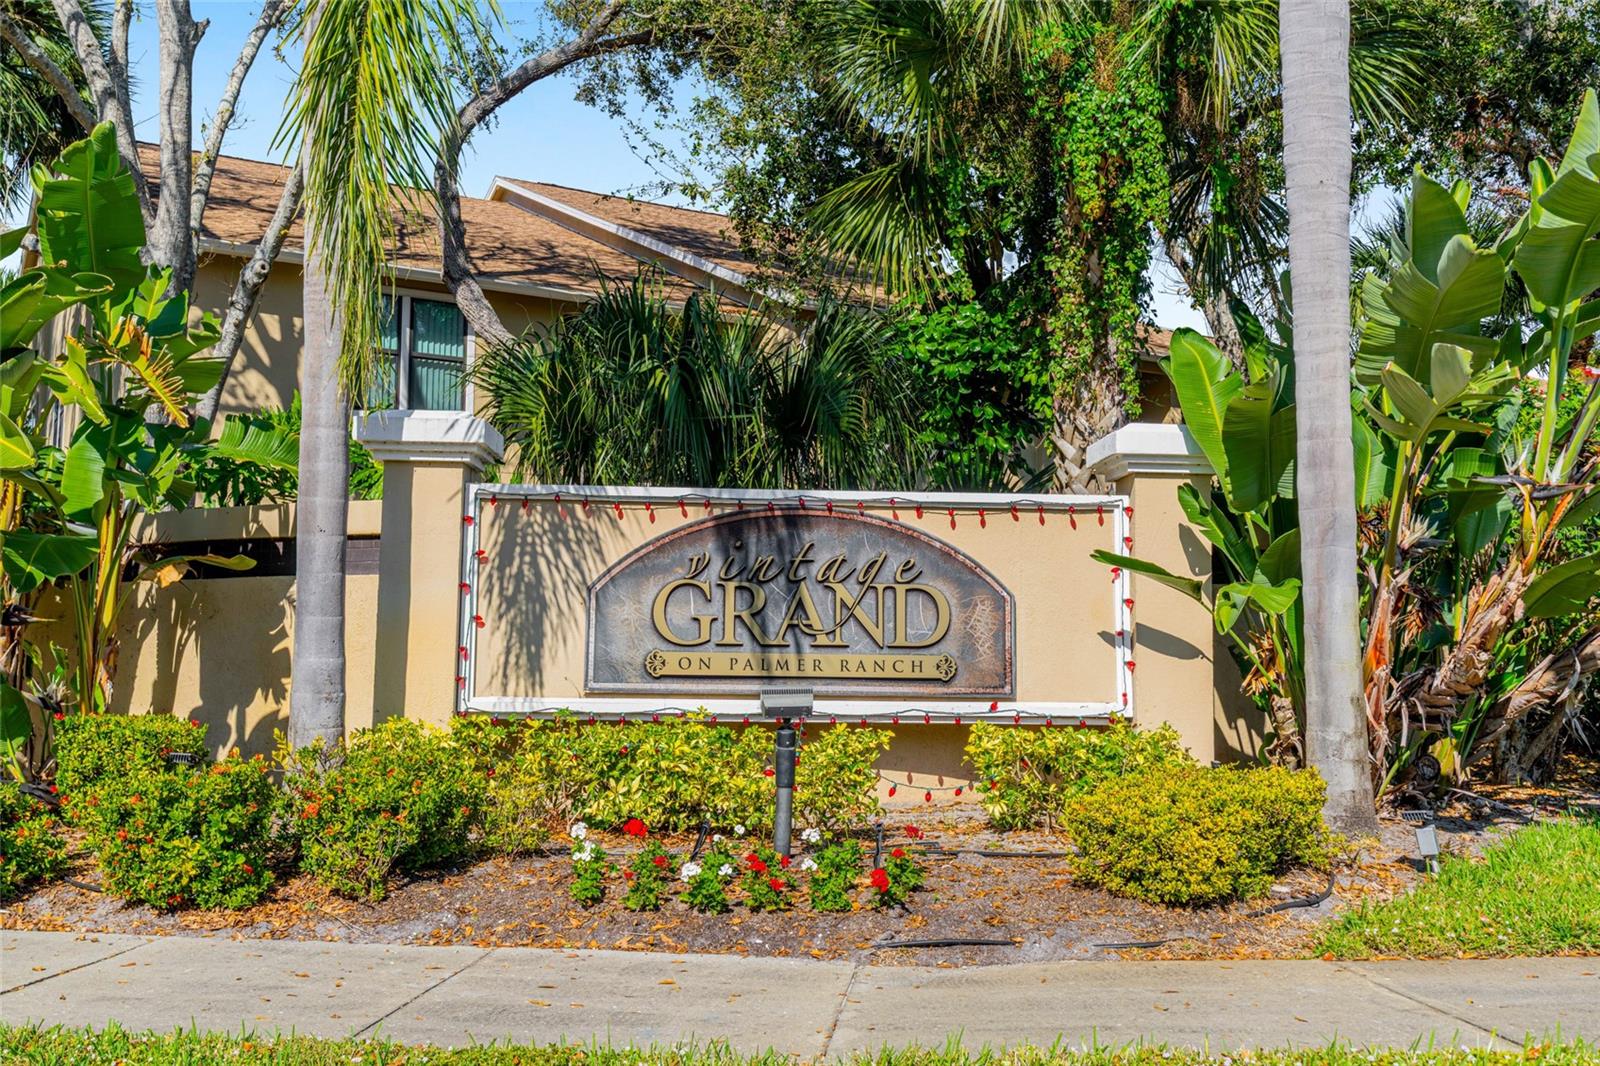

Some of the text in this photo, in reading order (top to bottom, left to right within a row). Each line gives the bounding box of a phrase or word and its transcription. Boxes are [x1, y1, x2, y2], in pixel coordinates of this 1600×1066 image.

[652, 578, 951, 649] GRAND
[687, 541, 923, 633] vintage
[677, 655, 925, 674] ON PALMER RANCH
